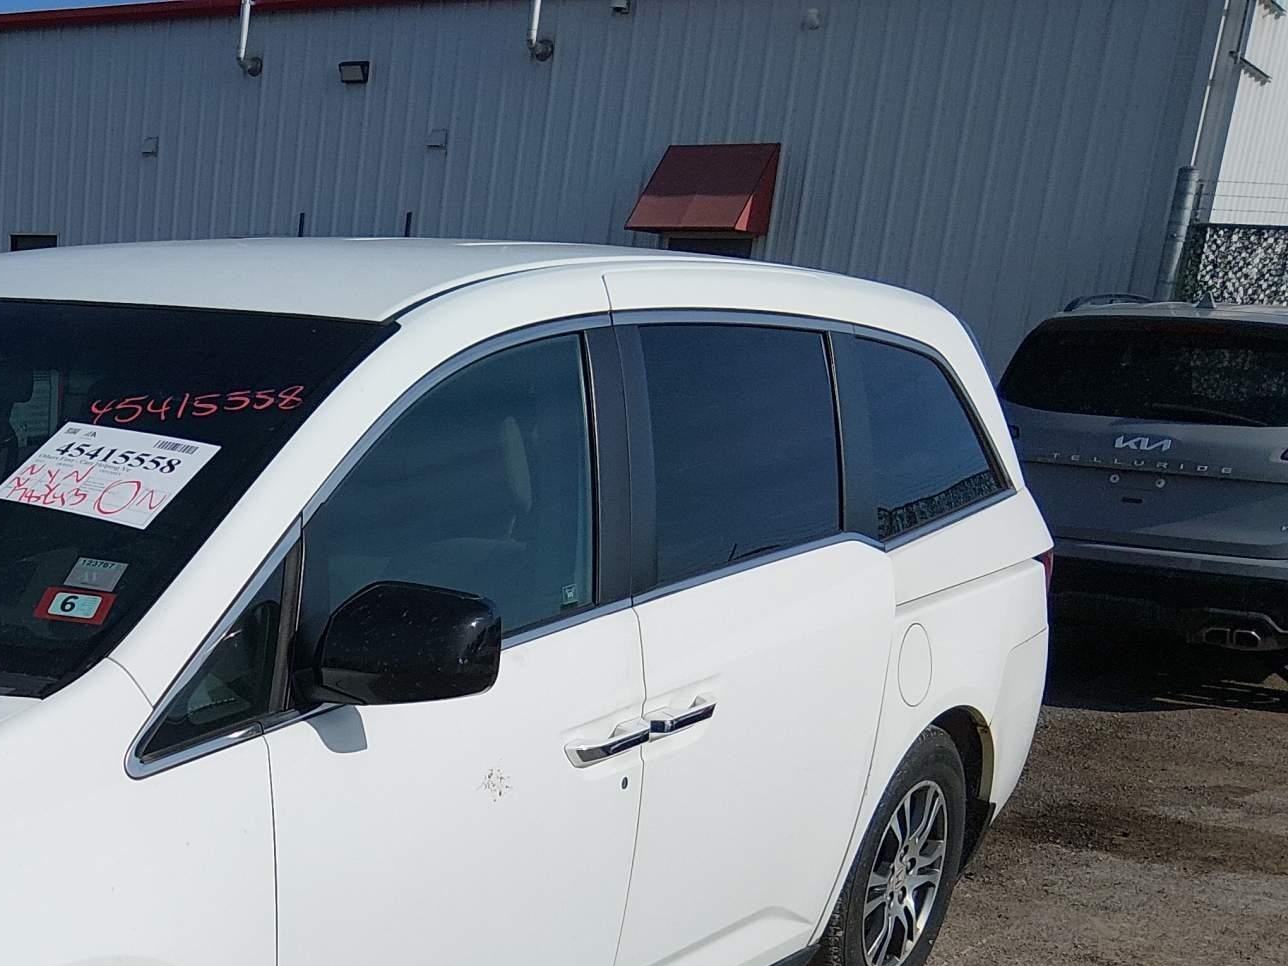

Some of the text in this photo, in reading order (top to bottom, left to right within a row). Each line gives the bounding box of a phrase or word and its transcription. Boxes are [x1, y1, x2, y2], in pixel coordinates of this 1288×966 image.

[90, 386, 305, 425] 45415558
[55, 441, 183, 475] 45415558
[1053, 452, 1233, 474] TELLURIDE
[60, 595, 80, 613] 6
